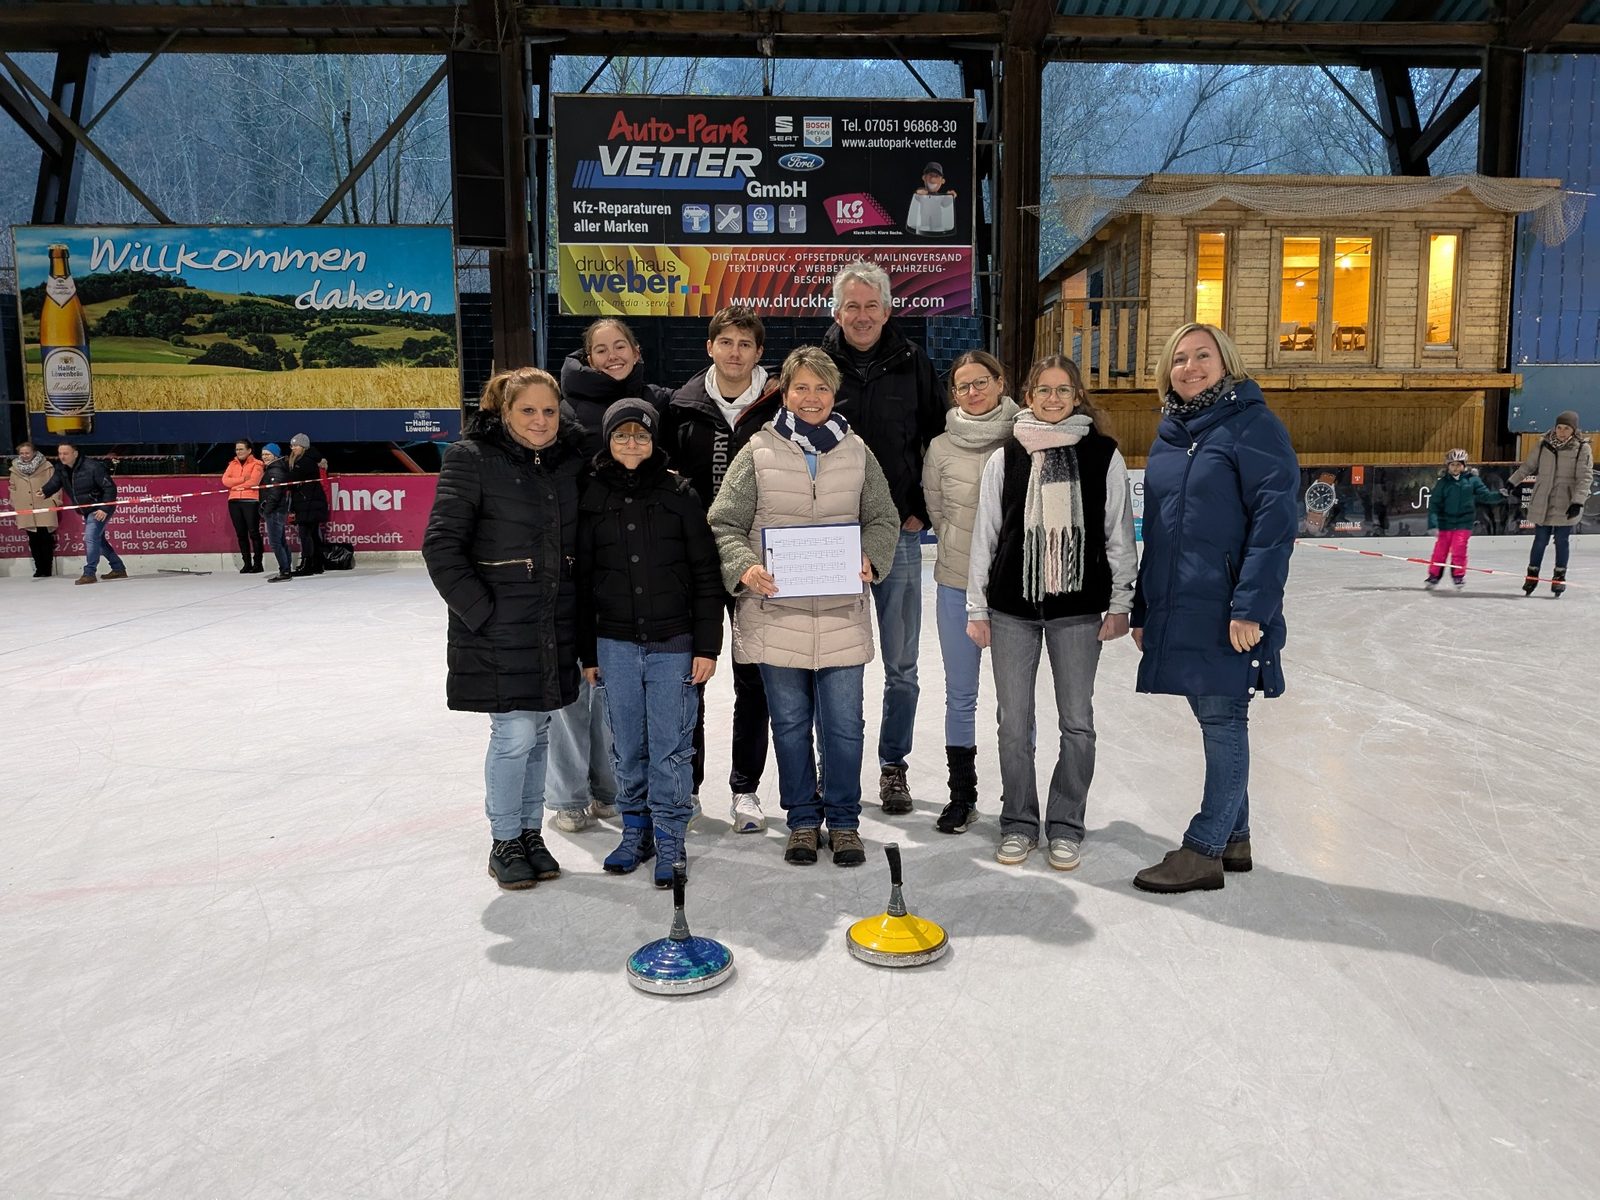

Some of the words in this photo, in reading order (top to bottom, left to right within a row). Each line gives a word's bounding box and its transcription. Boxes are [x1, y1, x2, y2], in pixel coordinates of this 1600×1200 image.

[607, 110, 749, 145] Auto-Park
[841, 119, 861, 132] Tel.
[864, 119, 899, 132] 07051
[903, 120, 957, 133] 96868-30
[841, 137, 957, 150] www.autopark-vetter.de
[598, 145, 763, 178] VETTER
[787, 155, 815, 168] Ford
[746, 180, 807, 198] GmbH
[573, 201, 672, 216] Kfz-Reparaturen
[573, 219, 601, 233] aller
[604, 219, 649, 233] Marken
[90, 236, 366, 275] Willkommen
[712, 253, 786, 262] DIGITALDRUCK
[794, 253, 865, 262] OFFSETDRUCK
[874, 253, 962, 262] MAILINGVERSAND
[728, 264, 796, 273] TEXTILDRUCK
[891, 264, 946, 273] FAHRZEUG-
[295, 279, 432, 312] daheim
[583, 299, 605, 307] print
[612, 299, 639, 307] media
[646, 299, 675, 307] service
[405, 425, 441, 433] Löwenbräu
[114, 530, 133, 539] Bad
[136, 529, 187, 539] Liebenzell
[121, 541, 140, 550] Fax
